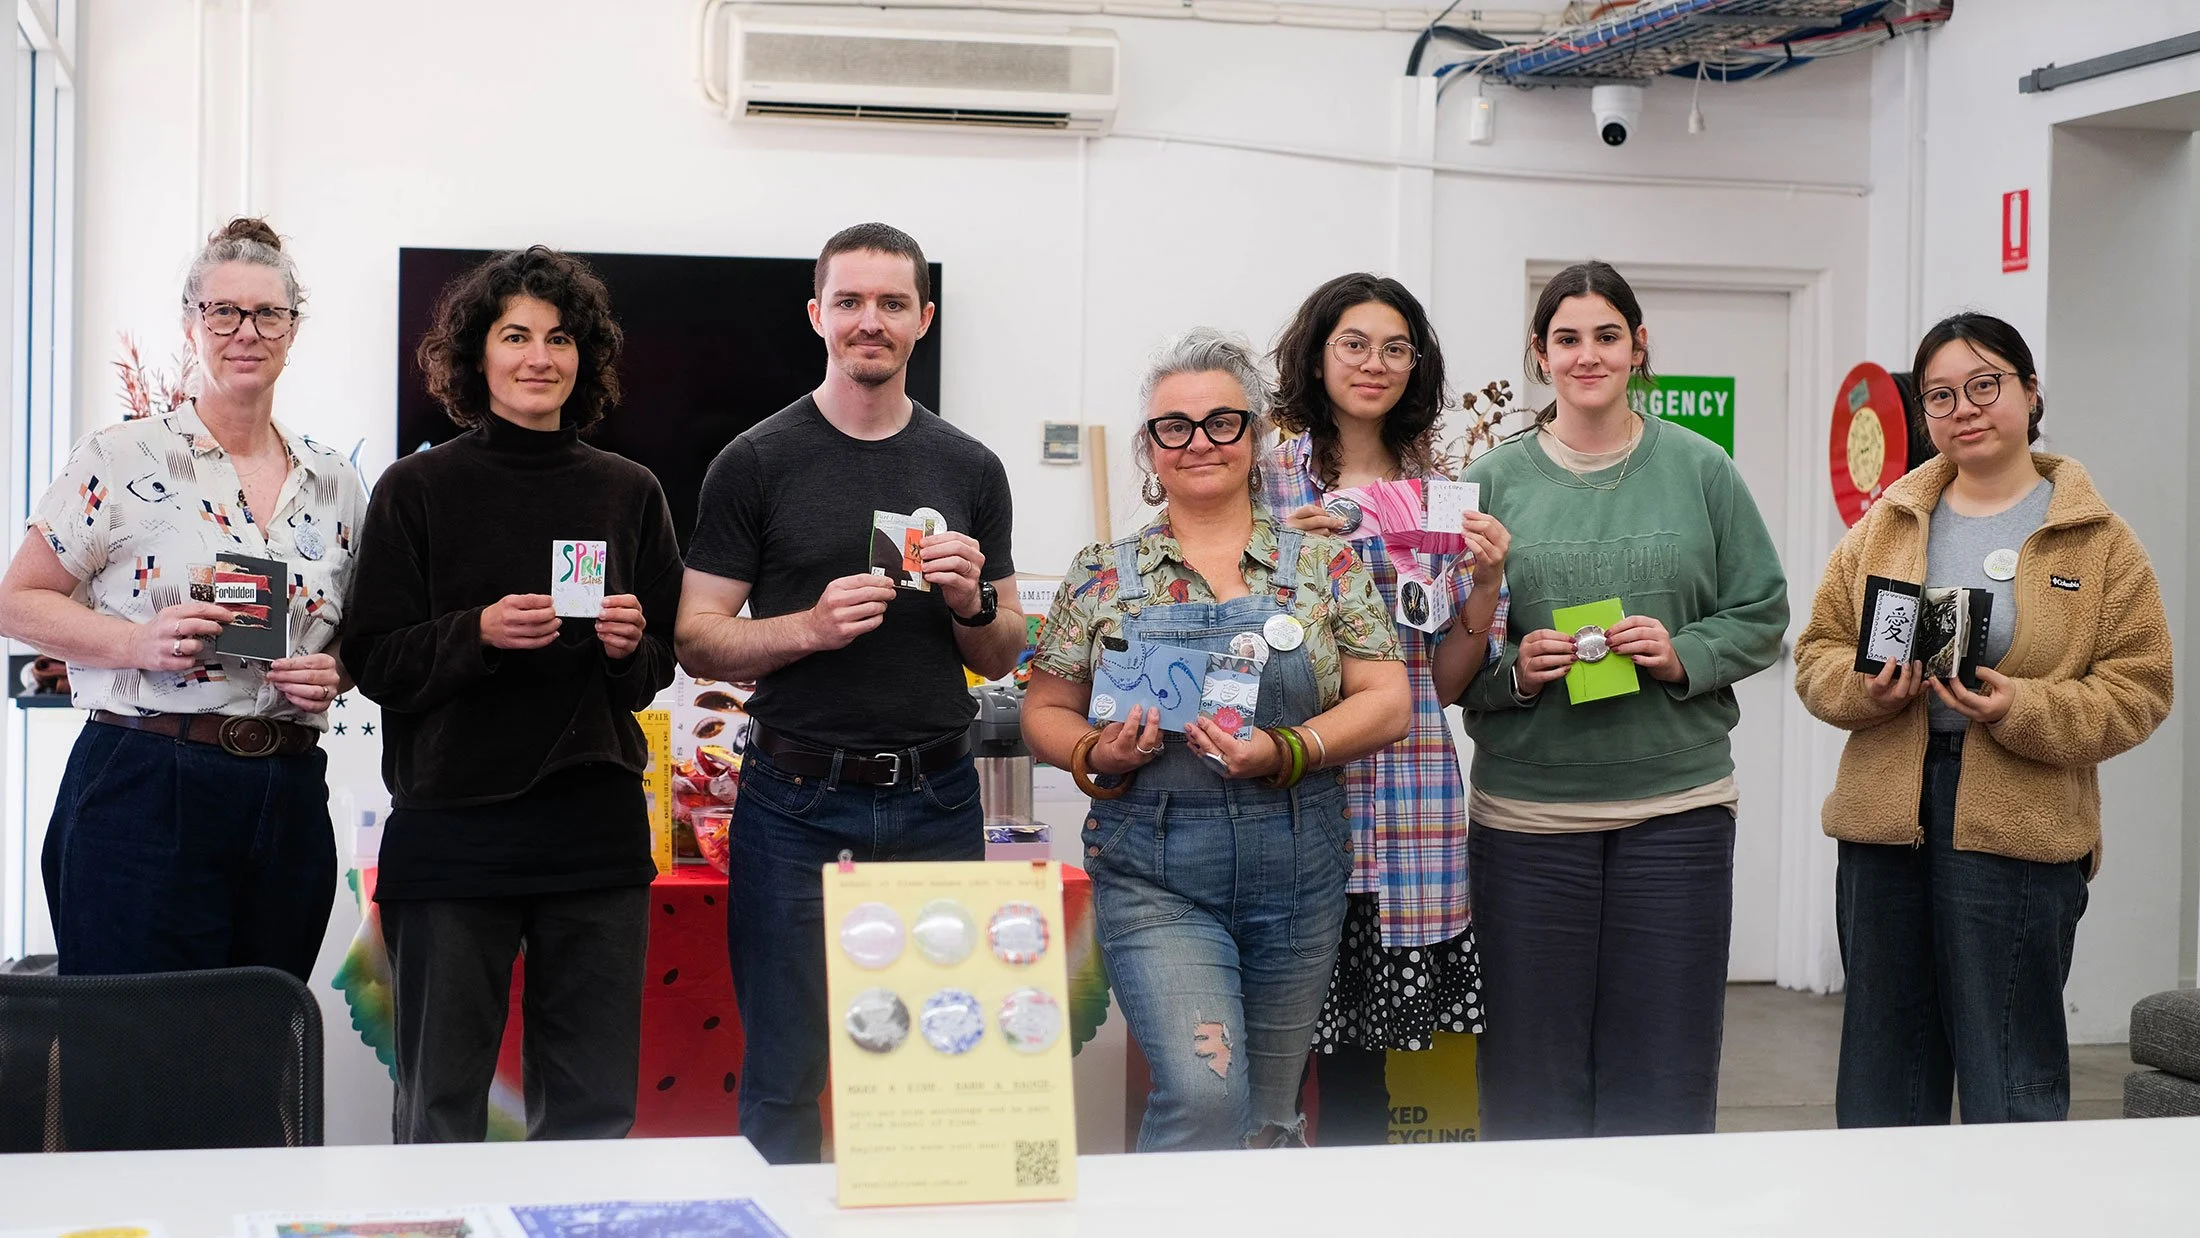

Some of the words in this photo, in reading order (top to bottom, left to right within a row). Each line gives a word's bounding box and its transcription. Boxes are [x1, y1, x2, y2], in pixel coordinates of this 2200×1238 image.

[1521, 551, 1616, 592] COUNTRY
[1623, 544, 1681, 584] ROAD
[2057, 578, 2080, 588] Columbia
[215, 585, 255, 599] Forbidden
[1880, 606, 1910, 645] 愛
[647, 713, 669, 721] FAIR
